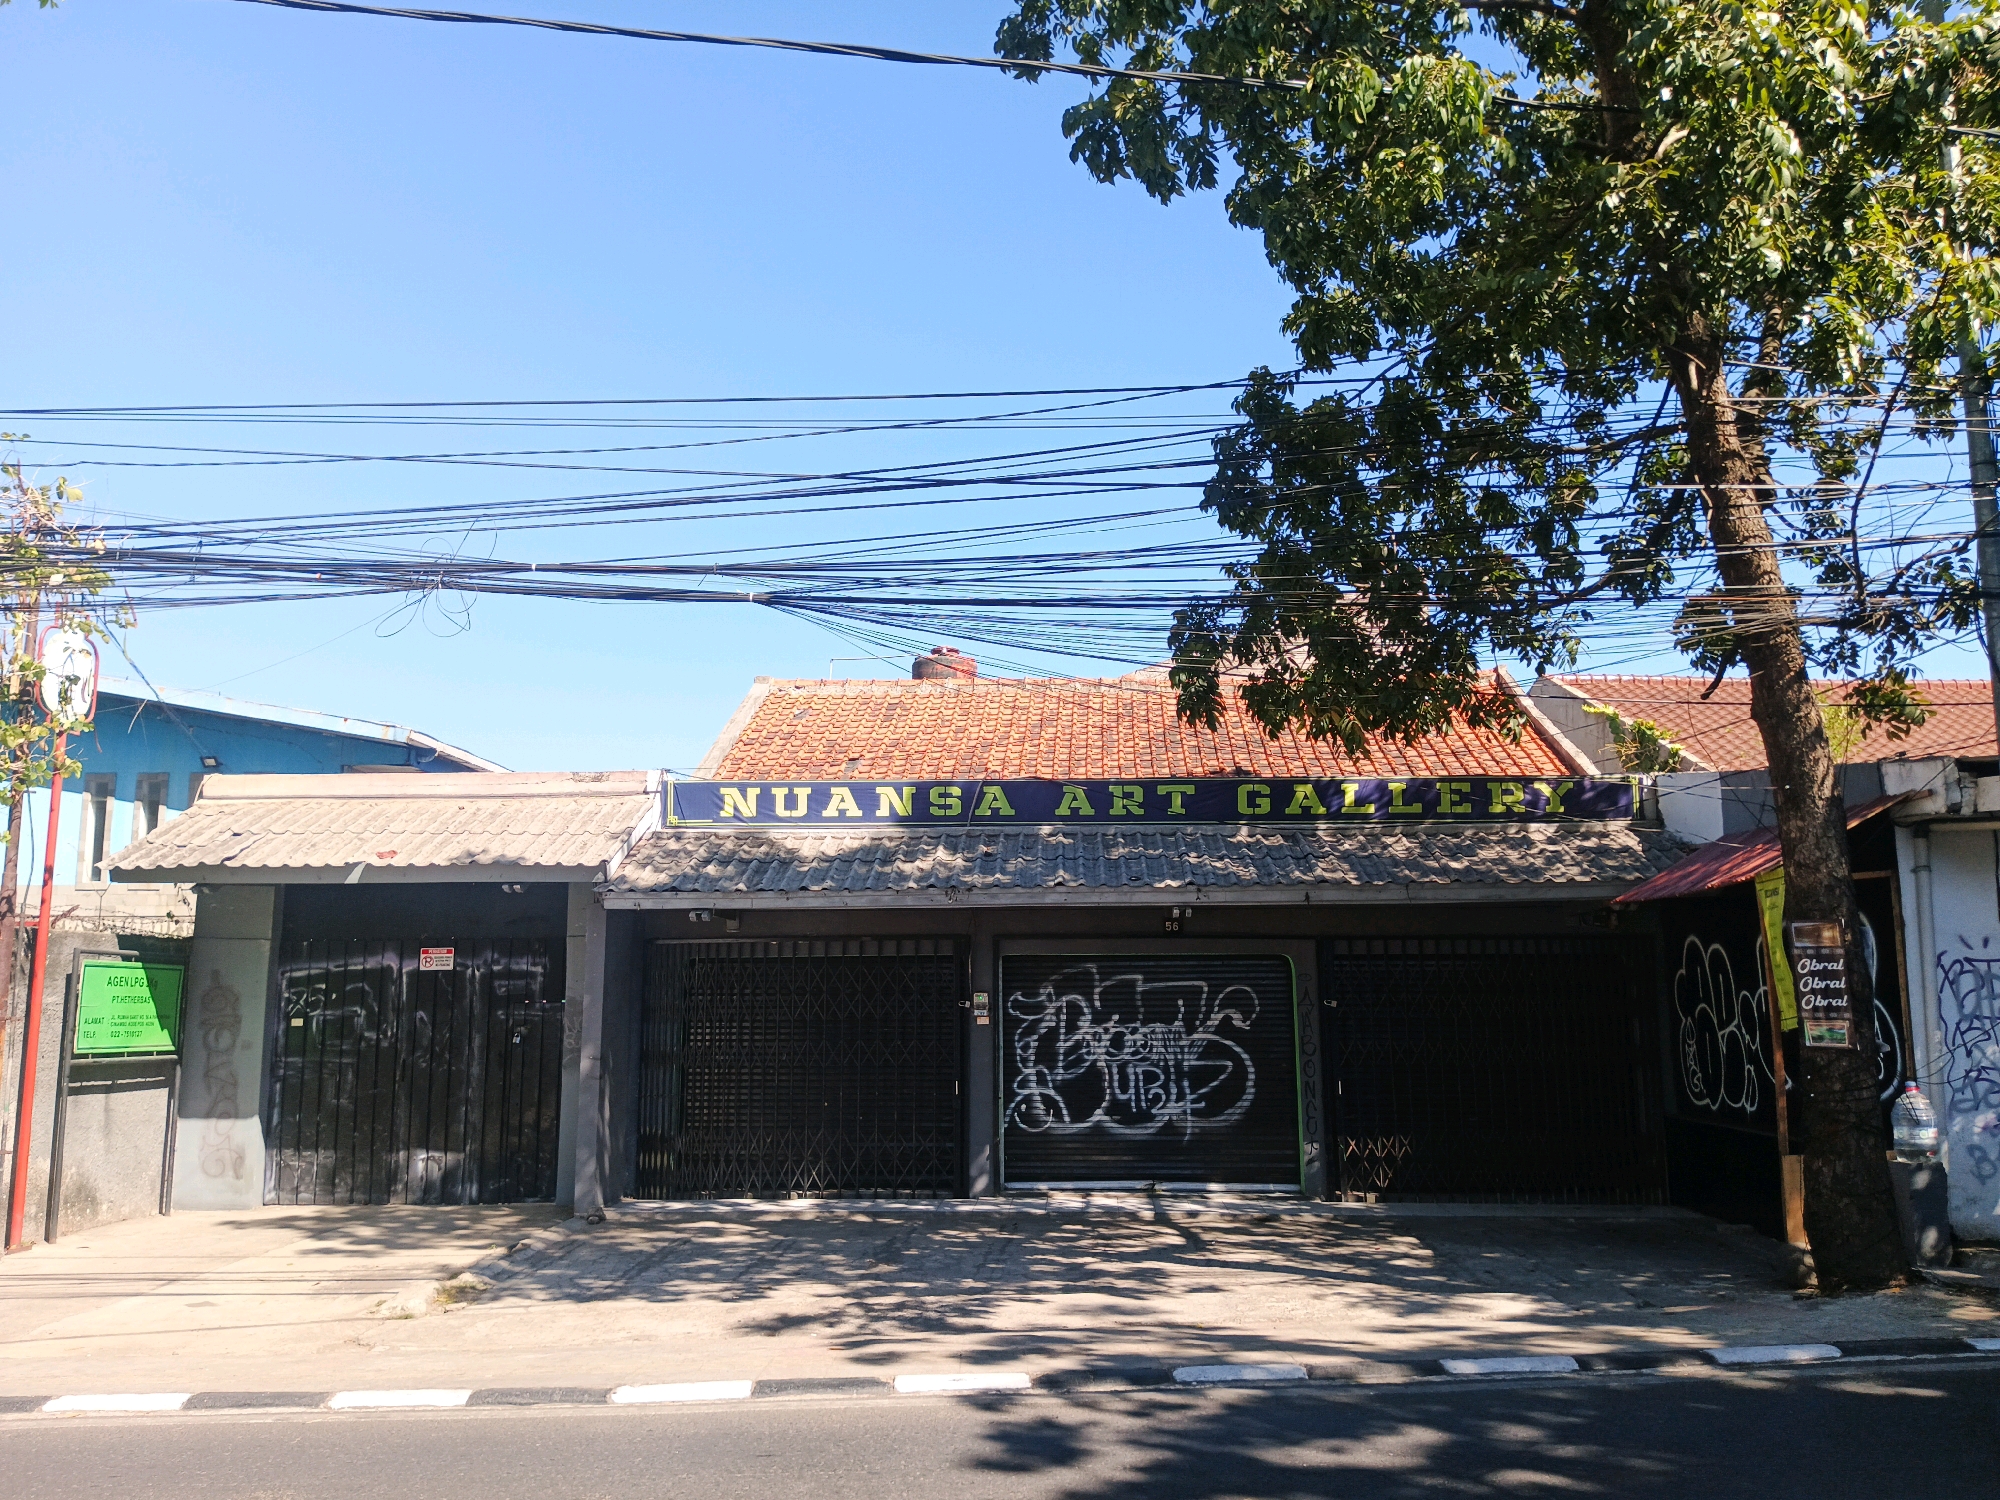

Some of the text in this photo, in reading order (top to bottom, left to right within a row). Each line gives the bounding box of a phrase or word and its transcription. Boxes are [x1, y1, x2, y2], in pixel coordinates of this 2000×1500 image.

[719, 781, 1574, 818] NUANSA ART GALLERY
[1165, 921, 1179, 931] 56
[1797, 958, 1845, 974] Obral
[106, 976, 129, 987] AGEN
[130, 976, 145, 988] LPG
[1800, 976, 1847, 992] Obral
[1801, 994, 1849, 1010] Obral
[84, 1017, 105, 1025] ALAMAT
